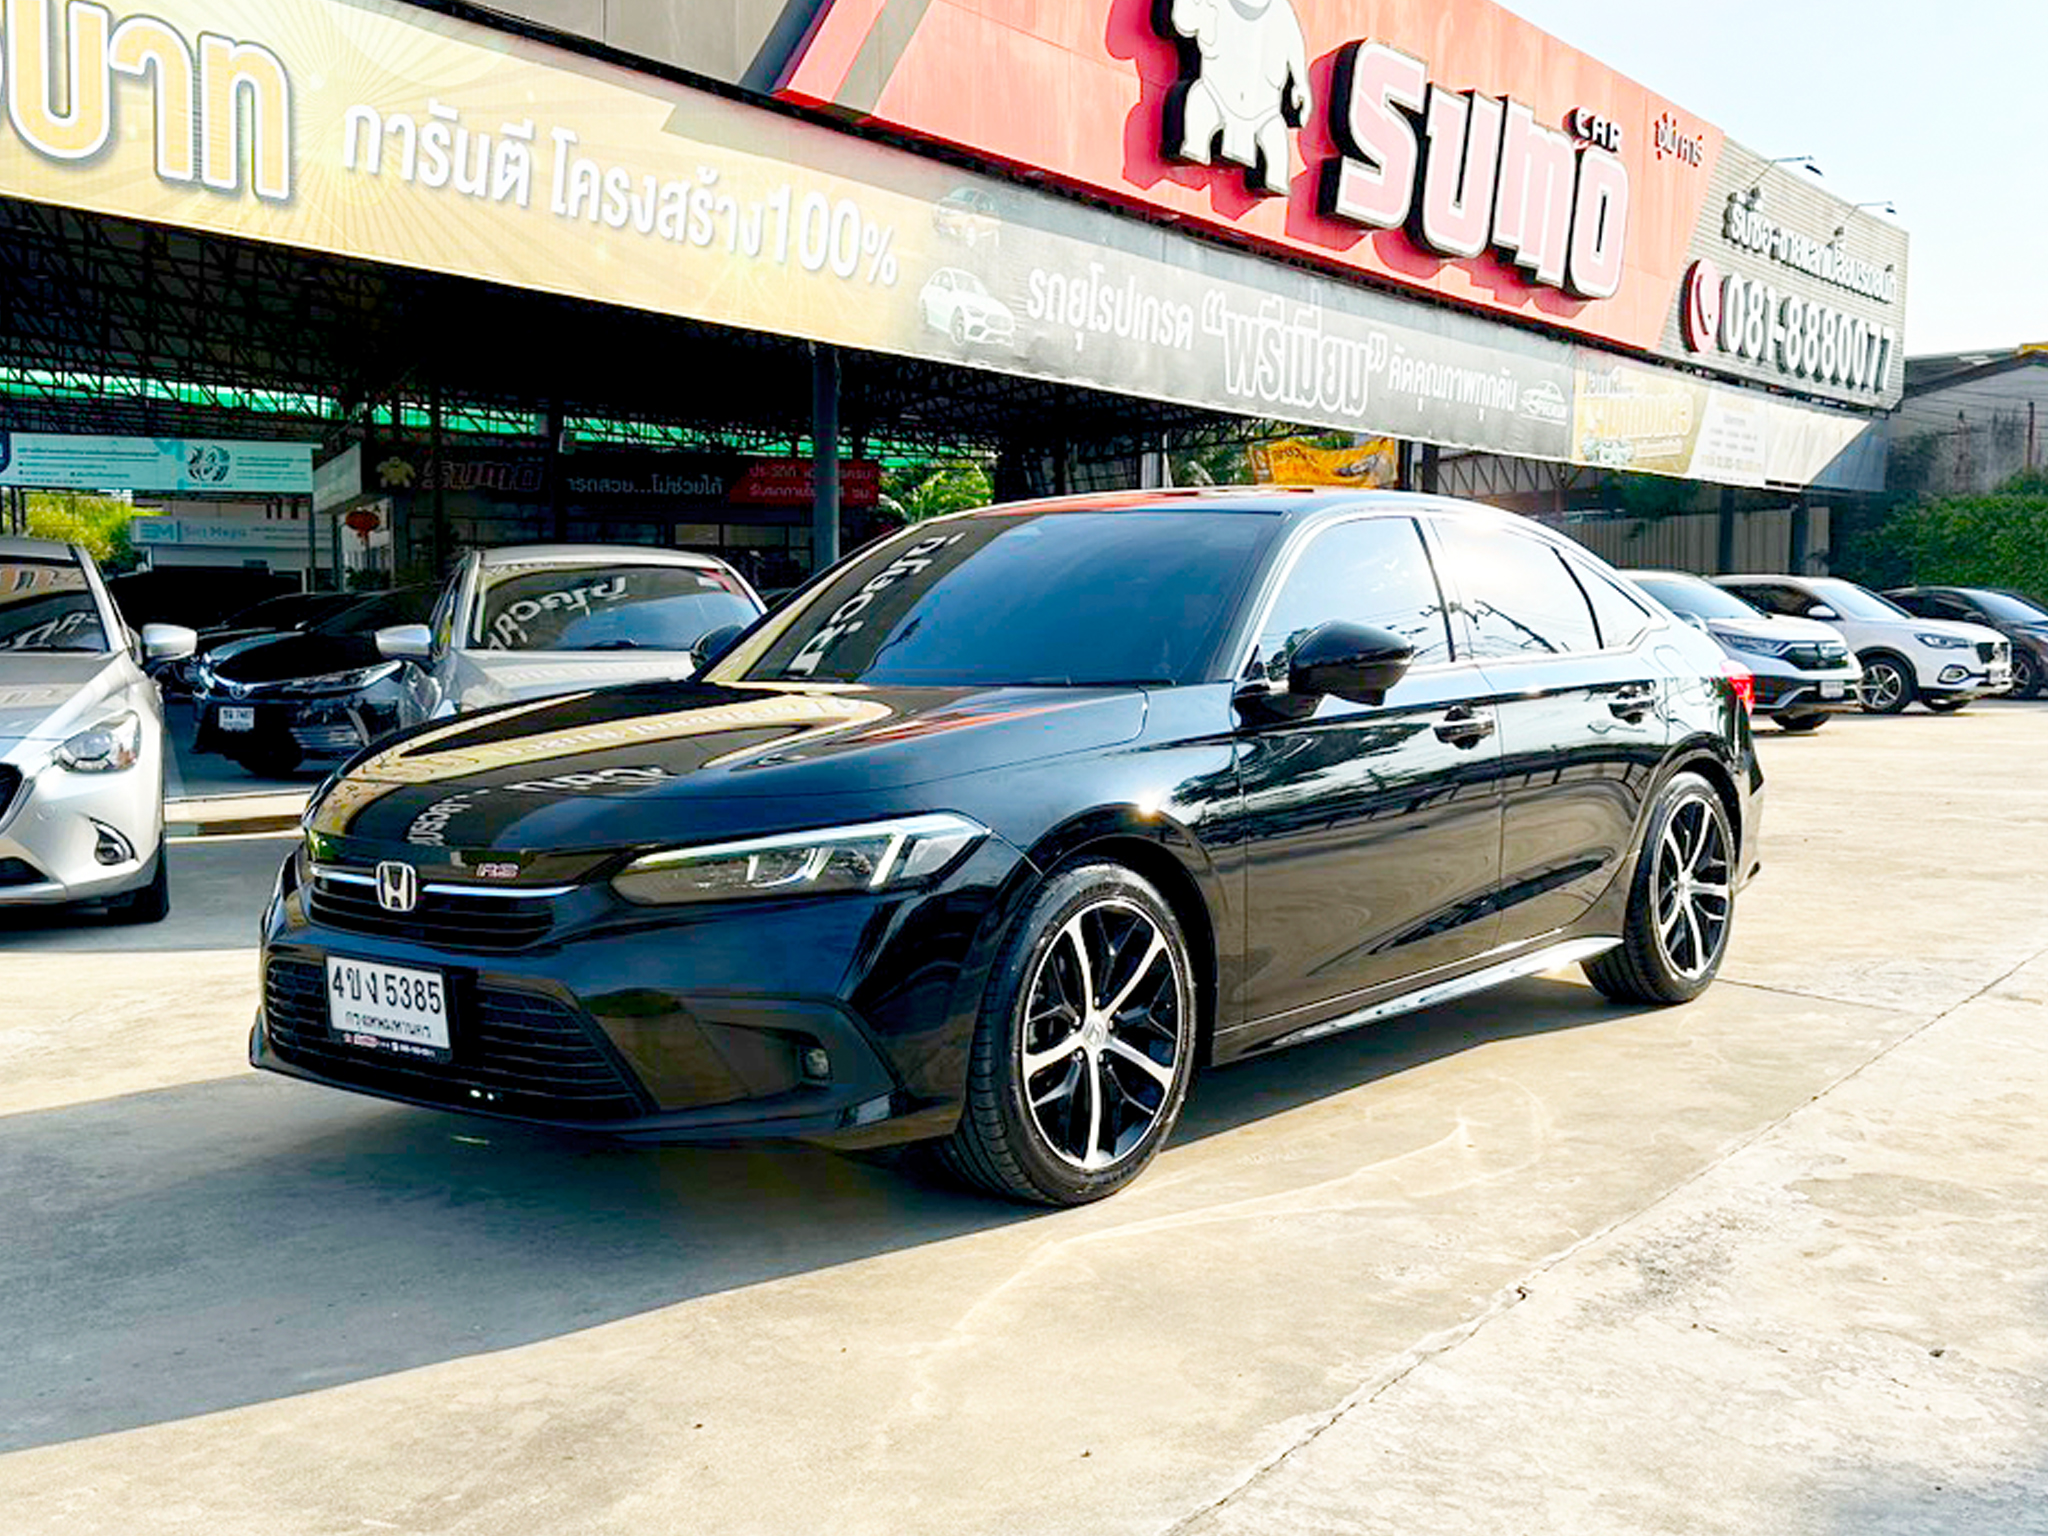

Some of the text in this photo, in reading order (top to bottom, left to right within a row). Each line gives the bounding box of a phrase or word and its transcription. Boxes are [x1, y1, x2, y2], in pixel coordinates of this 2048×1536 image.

[343, 97, 534, 208] การันตี
[1575, 106, 1622, 154] CAR
[1026, 261, 1195, 352] รถยุโรปเกรด
[1387, 344, 1518, 421] คัดคุณภาพทุกคัน
[1724, 271, 1895, 392] 081-8880077
[476, 862, 520, 879] RS
[384, 973, 442, 1014] 5385
